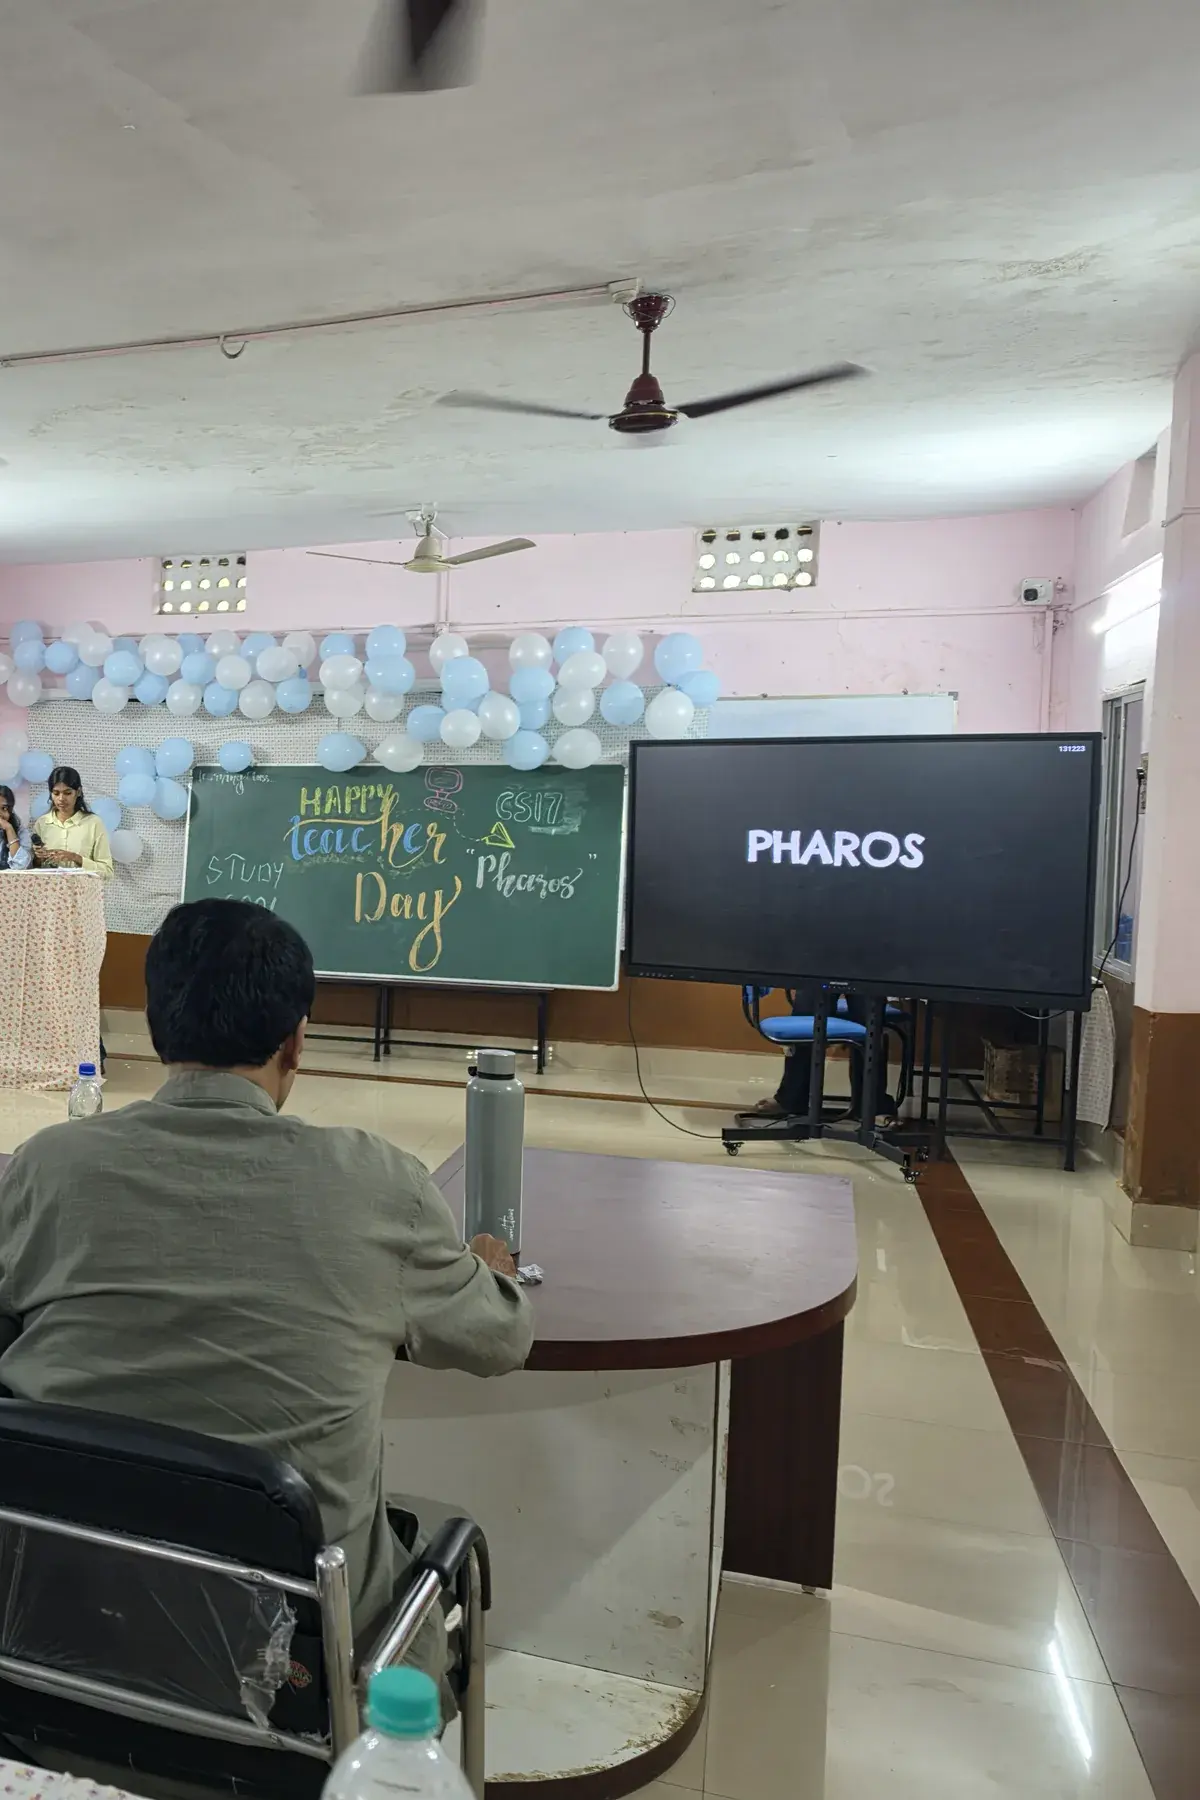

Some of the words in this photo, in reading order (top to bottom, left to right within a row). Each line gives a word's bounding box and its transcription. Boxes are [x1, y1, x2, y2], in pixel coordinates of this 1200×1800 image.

[300, 784, 394, 816] HAPPY
[747, 829, 926, 869] PHAROS
[206, 853, 284, 889] STUDY
[355, 871, 462, 972] Day
